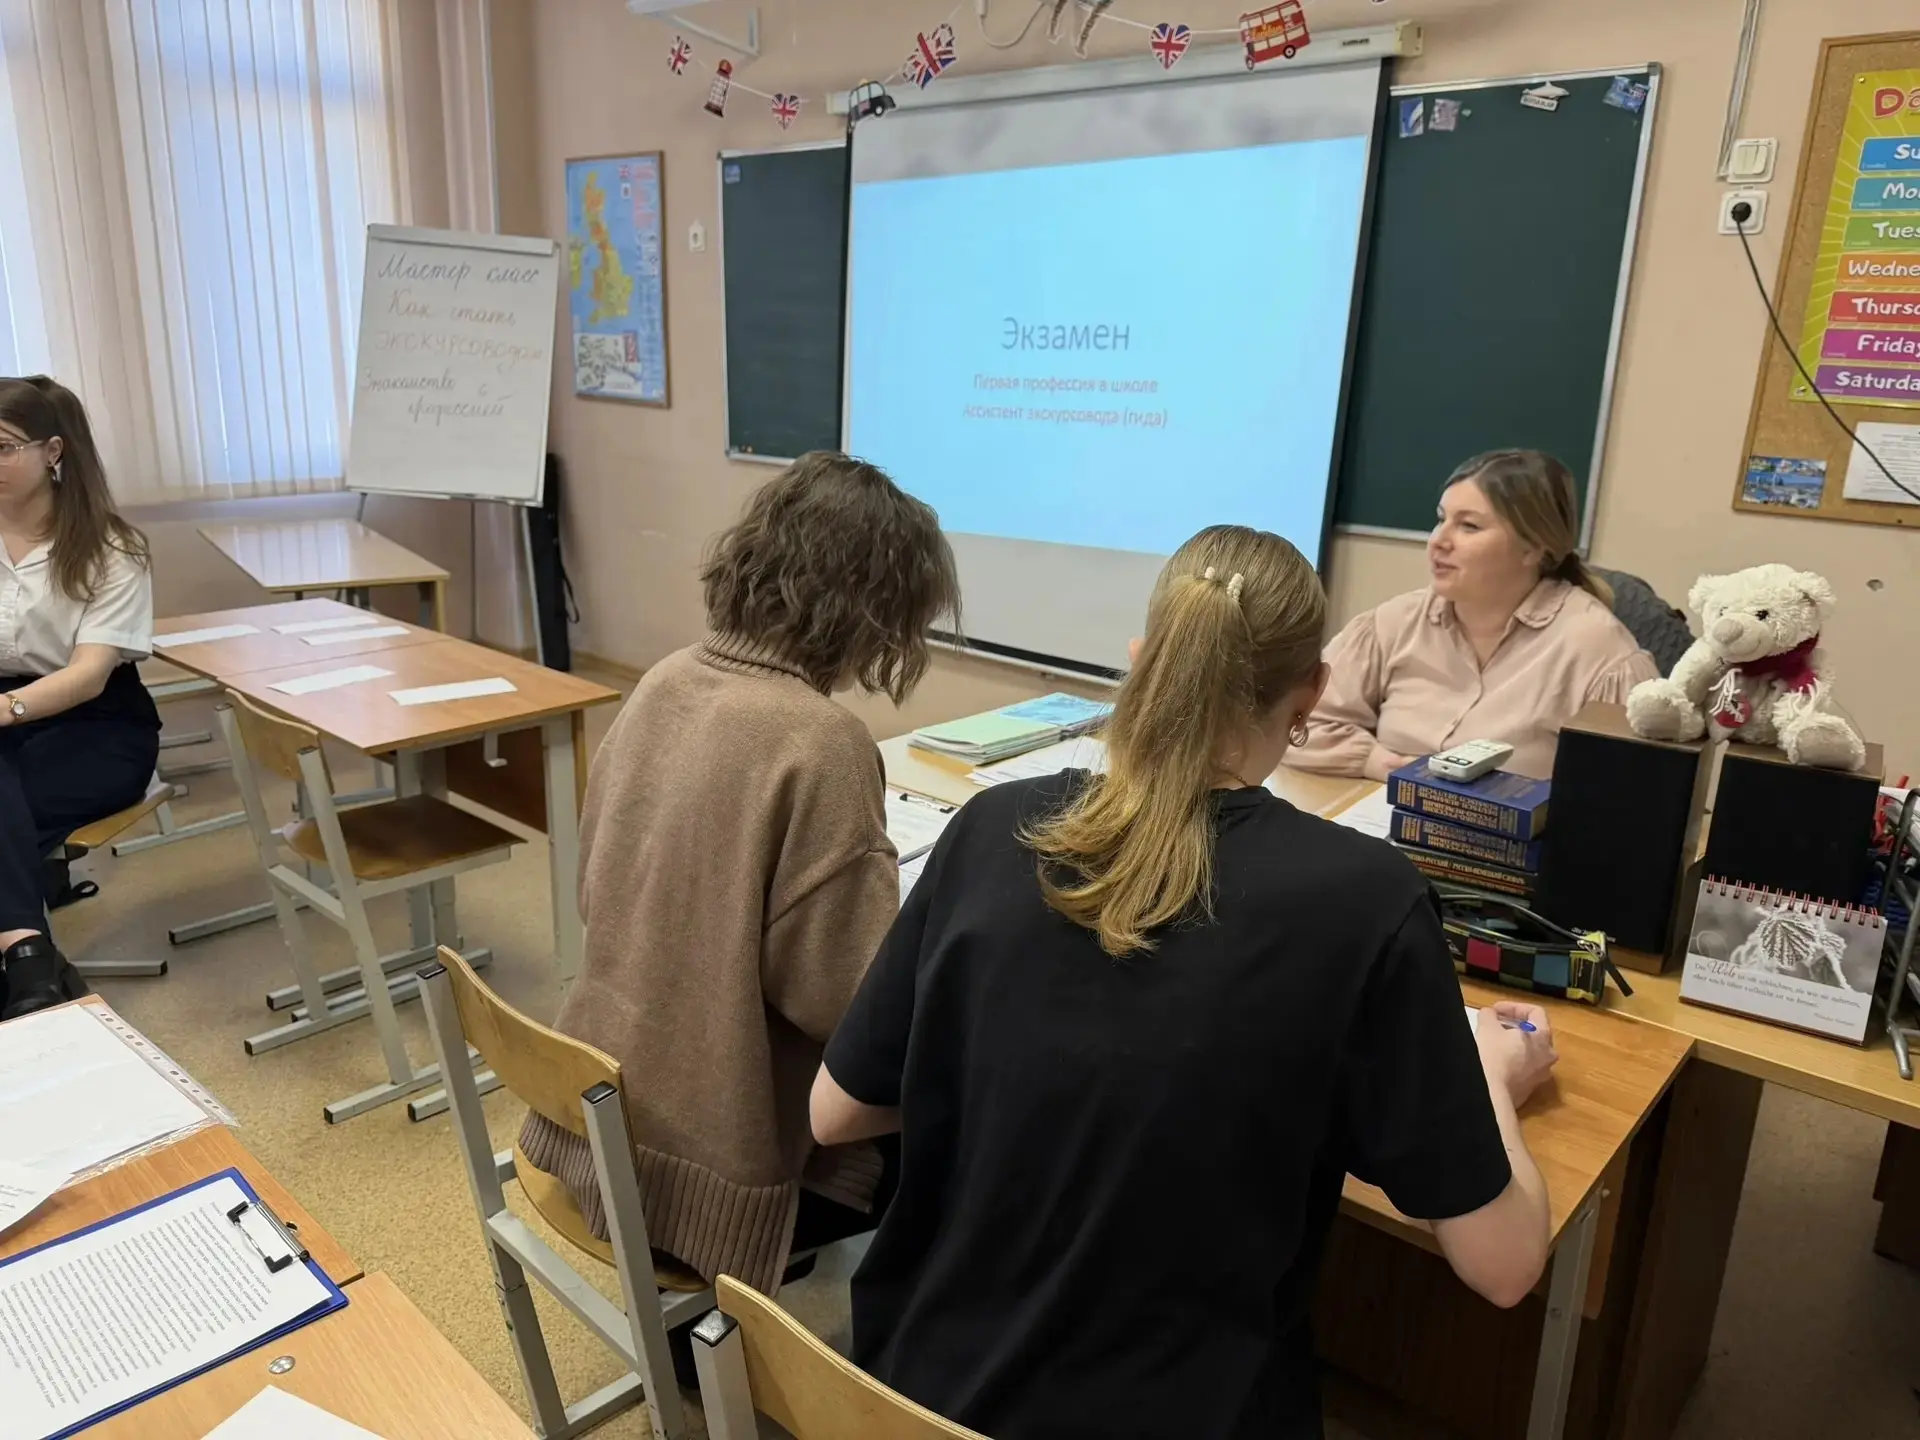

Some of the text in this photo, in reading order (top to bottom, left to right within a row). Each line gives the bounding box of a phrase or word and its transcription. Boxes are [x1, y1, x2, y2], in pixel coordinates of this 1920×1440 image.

[377, 250, 472, 290] Мастер
[388, 287, 433, 318] Как
[1001, 316, 1130, 351] Экзамен
[974, 373, 1020, 391] Первая
[1111, 379, 1159, 394] школе
